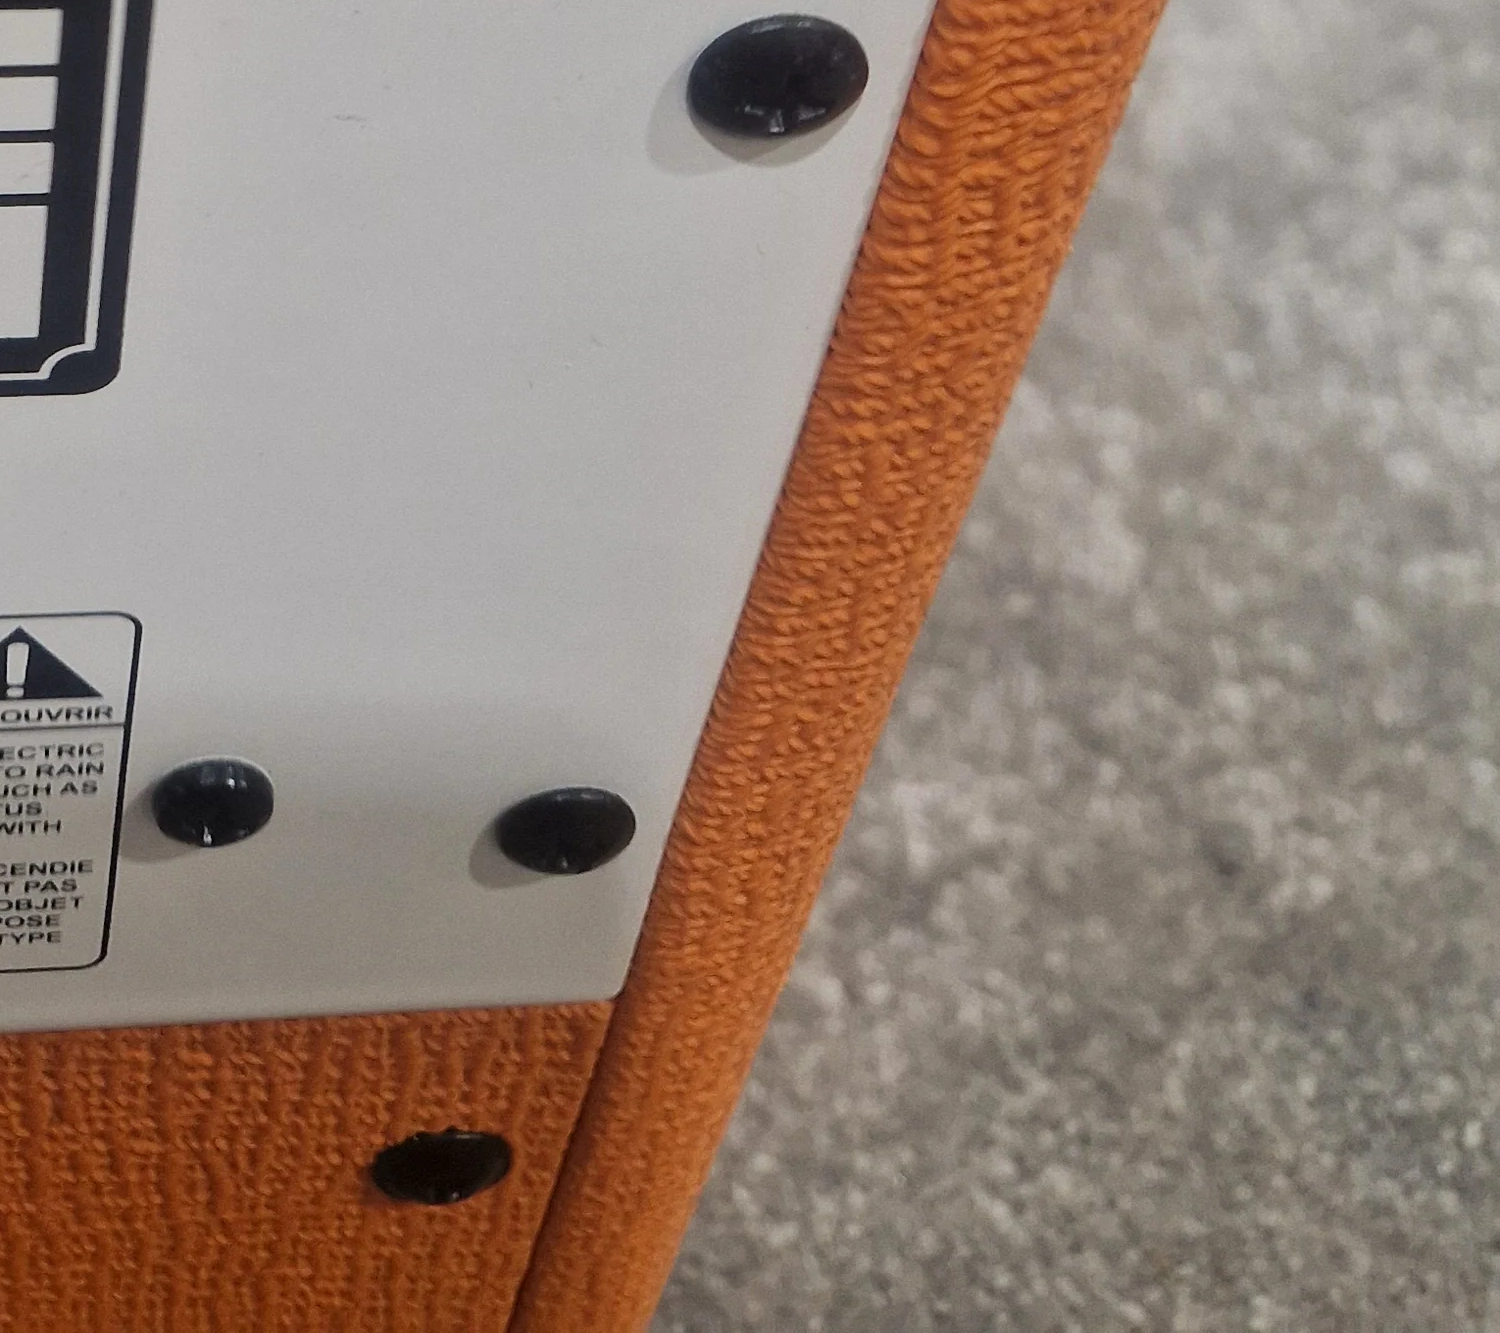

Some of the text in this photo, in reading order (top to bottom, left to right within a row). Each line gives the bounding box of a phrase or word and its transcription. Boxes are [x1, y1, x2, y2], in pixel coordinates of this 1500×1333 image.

[0, 706, 113, 723] OUVRIR
[35, 762, 104, 779] RAIN
[59, 781, 98, 796] AS
[24, 878, 77, 894] PAS
